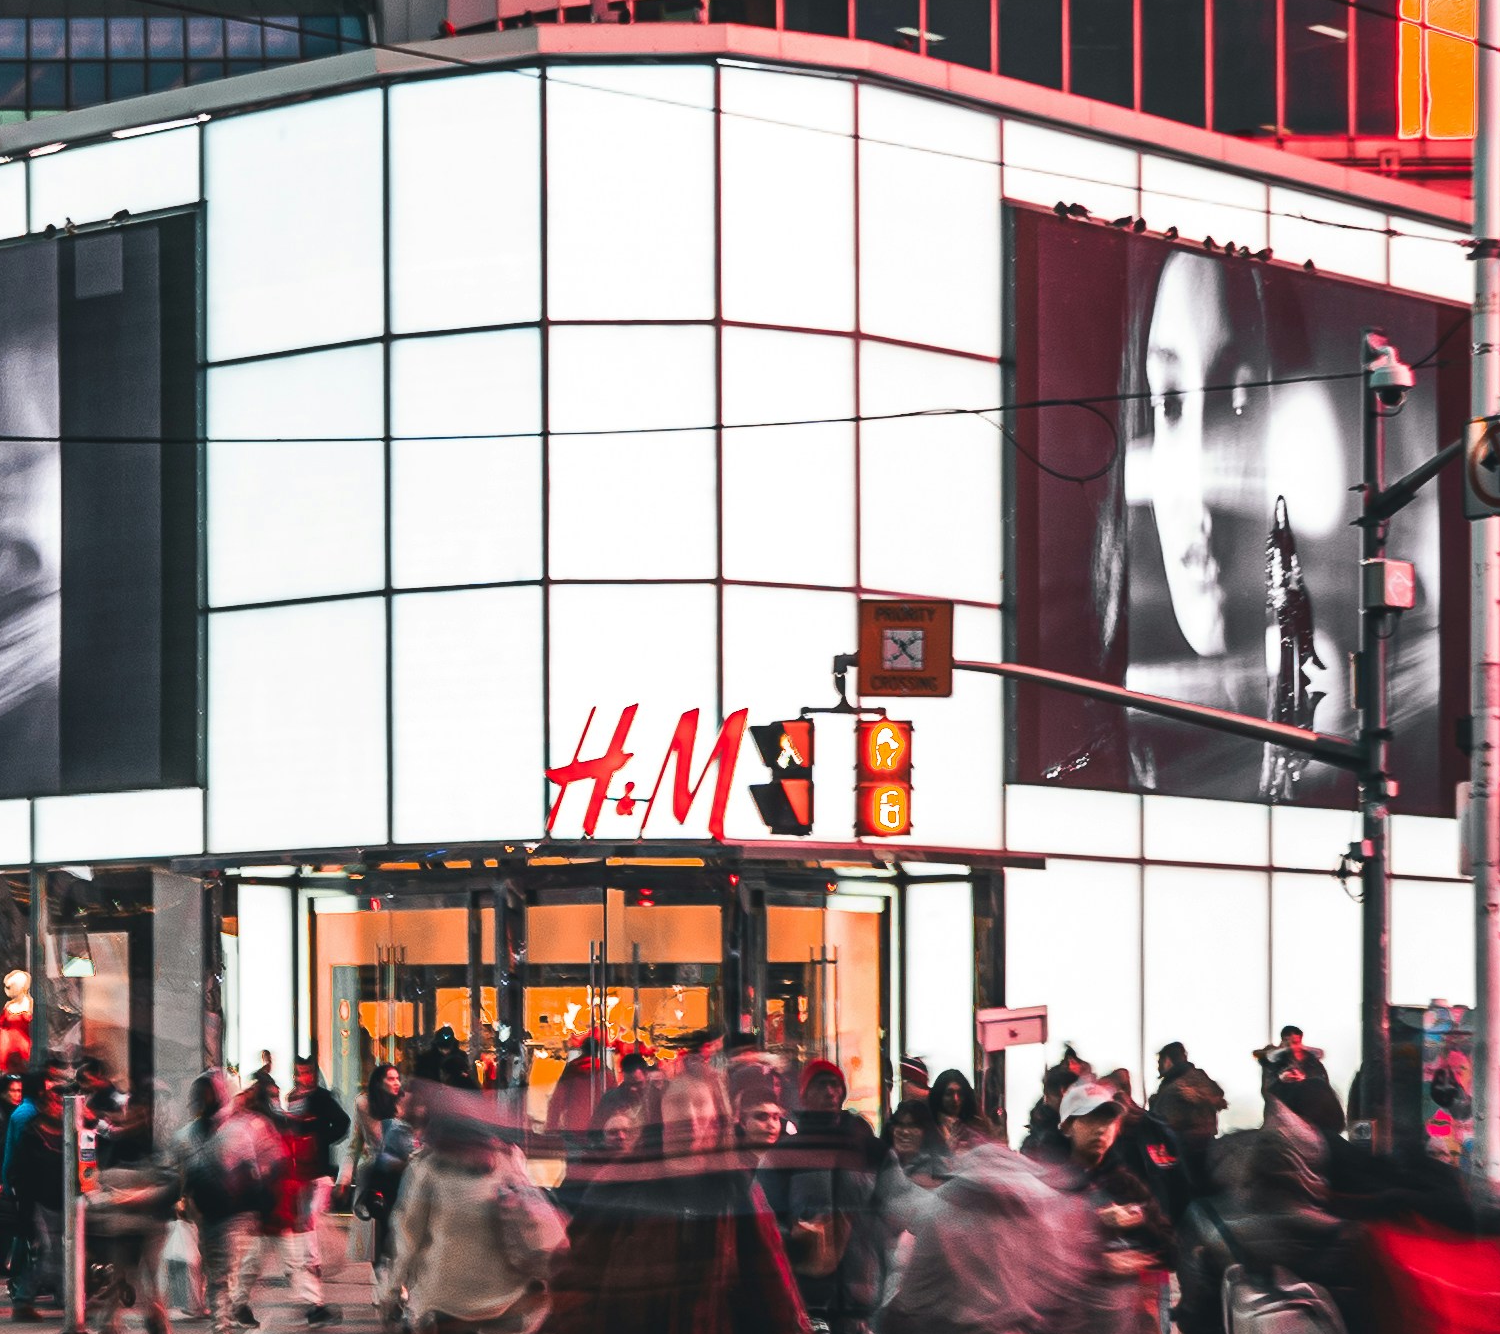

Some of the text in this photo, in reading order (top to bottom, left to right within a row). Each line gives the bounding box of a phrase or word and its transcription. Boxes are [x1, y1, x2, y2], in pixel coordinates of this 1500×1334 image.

[874, 606, 936, 623] PRIORITY
[870, 674, 939, 691] CROSSING
[545, 702, 749, 841] H&M
